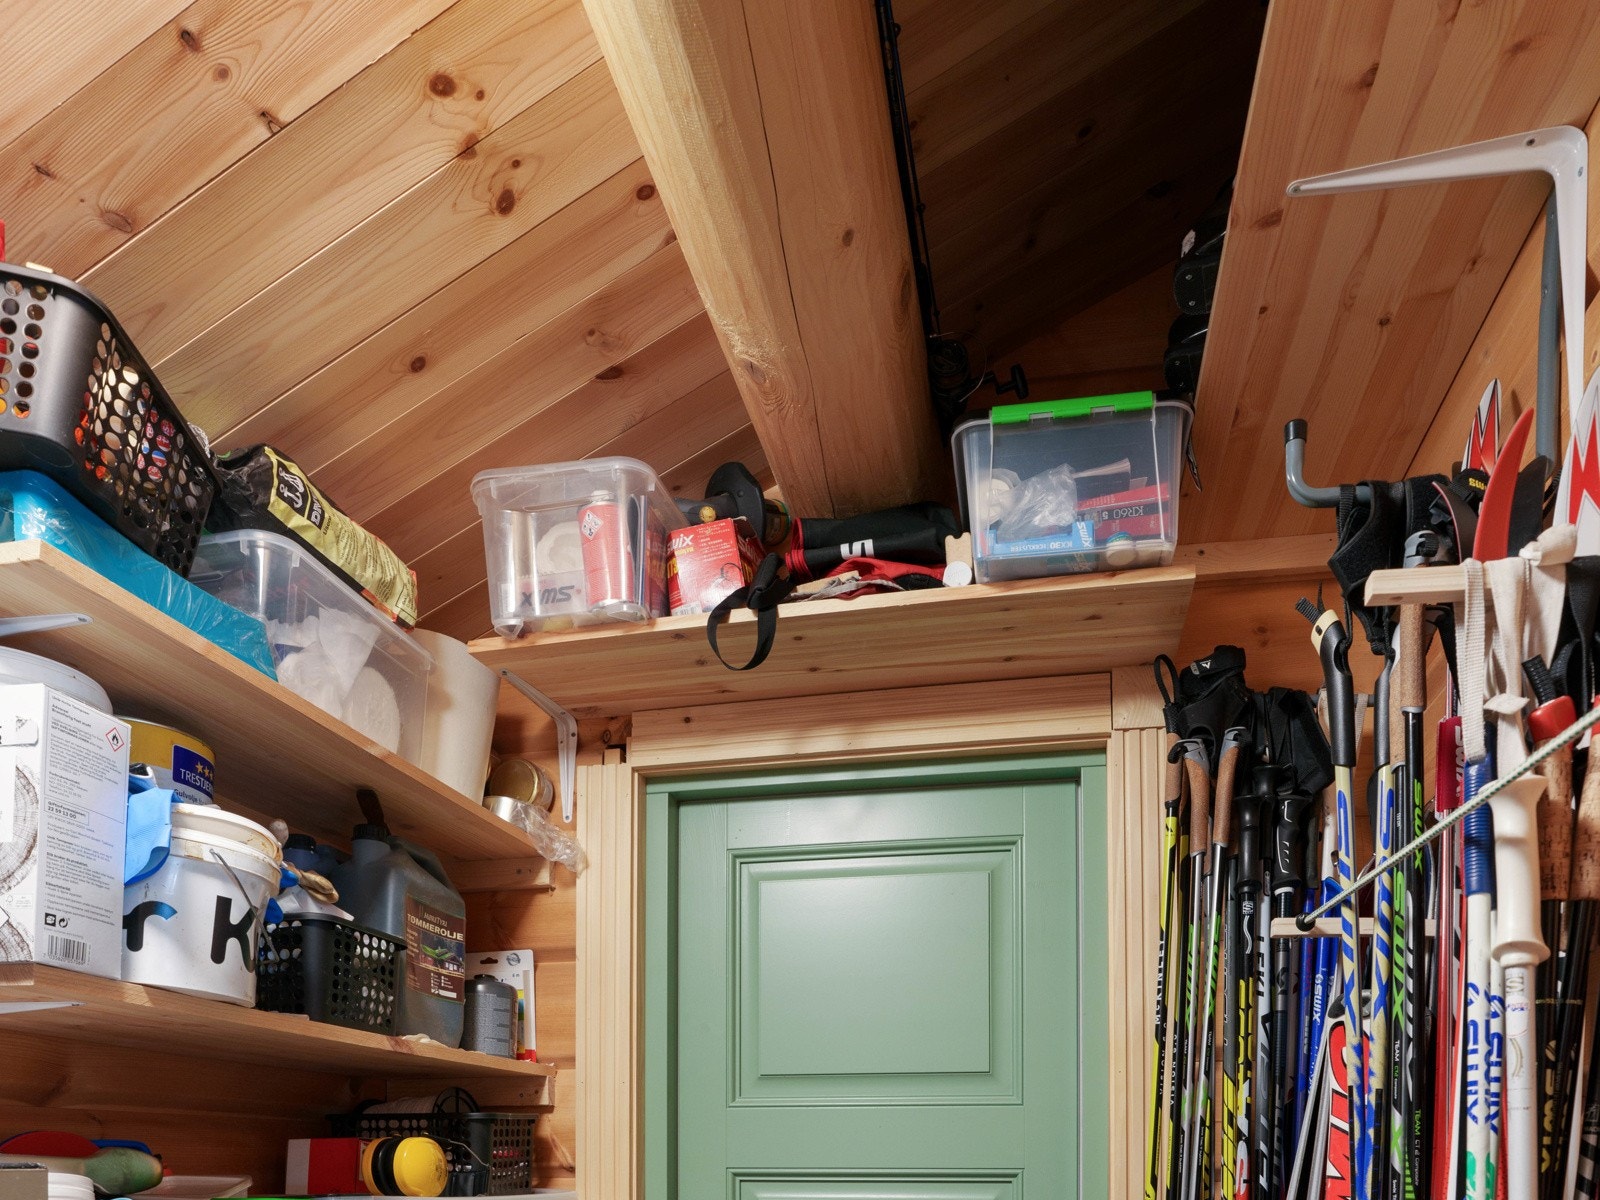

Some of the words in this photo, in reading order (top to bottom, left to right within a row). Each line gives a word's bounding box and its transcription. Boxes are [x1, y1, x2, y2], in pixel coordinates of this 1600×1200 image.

[1113, 505, 1144, 520] KR60
[1412, 778, 1424, 875] SWX
[1312, 983, 1323, 1025] SWIX
[1414, 1108, 1422, 1137] TEAM
